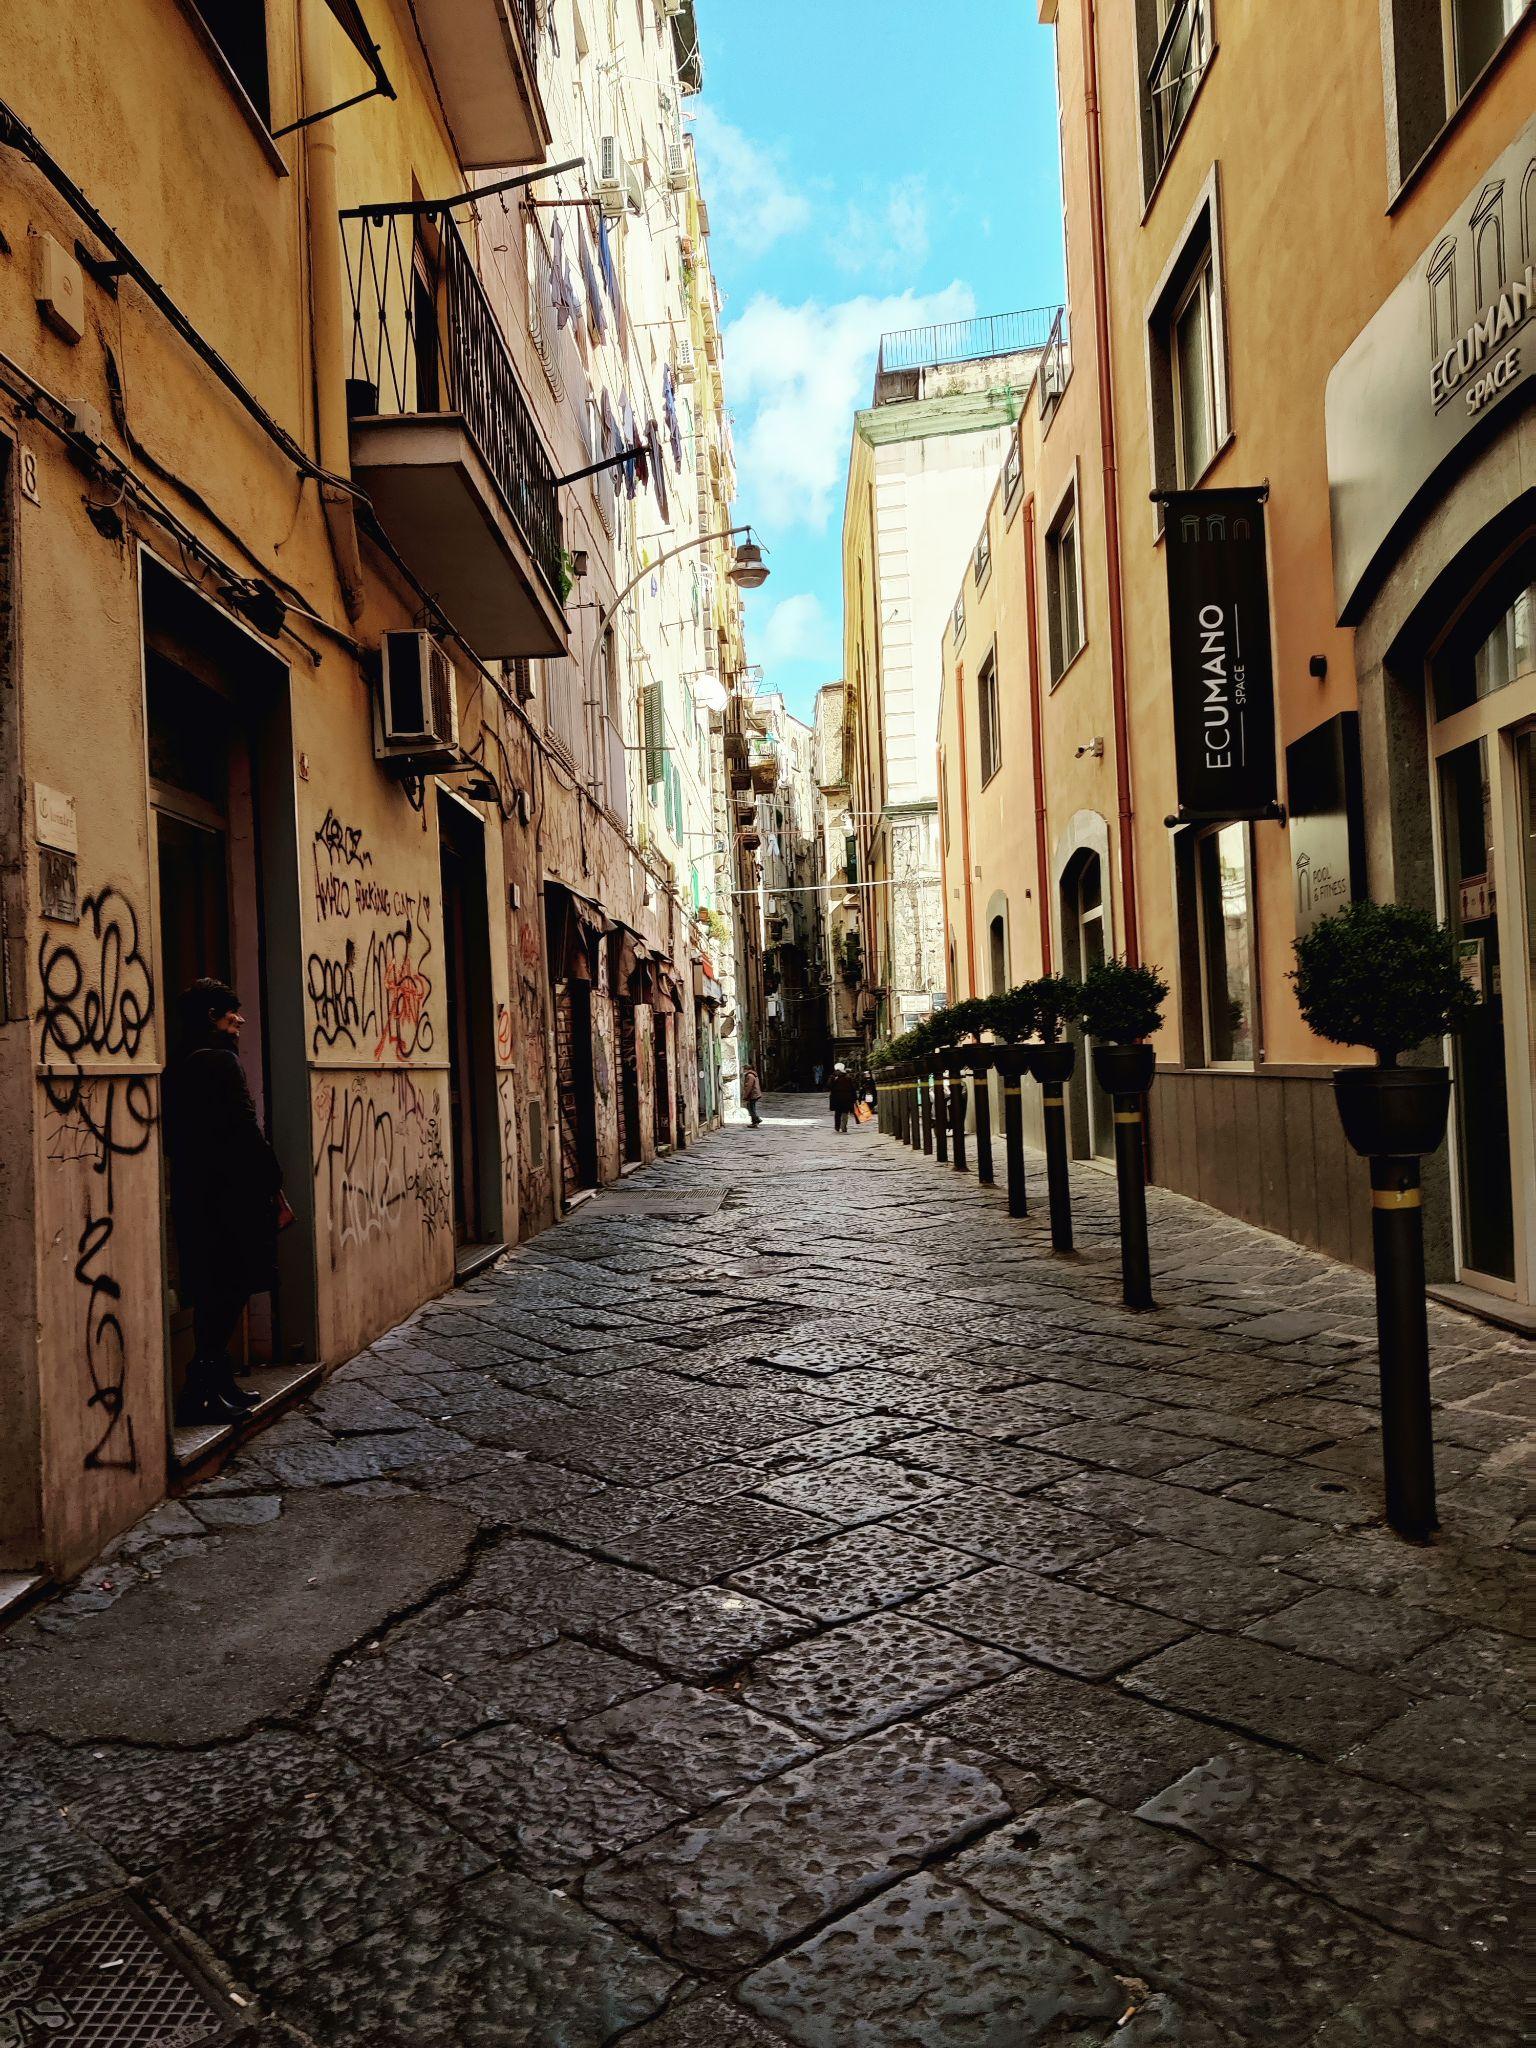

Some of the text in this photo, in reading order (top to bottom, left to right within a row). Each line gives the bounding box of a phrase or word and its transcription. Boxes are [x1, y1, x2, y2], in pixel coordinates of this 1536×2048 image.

[1466, 347, 1520, 416] SPACE
[24, 453, 36, 494] 8
[1198, 604, 1232, 769] ECUMANO
[1233, 664, 1247, 705] SPACE
[1313, 863, 1331, 883] POOL
[1320, 878, 1346, 898] FITNESS
